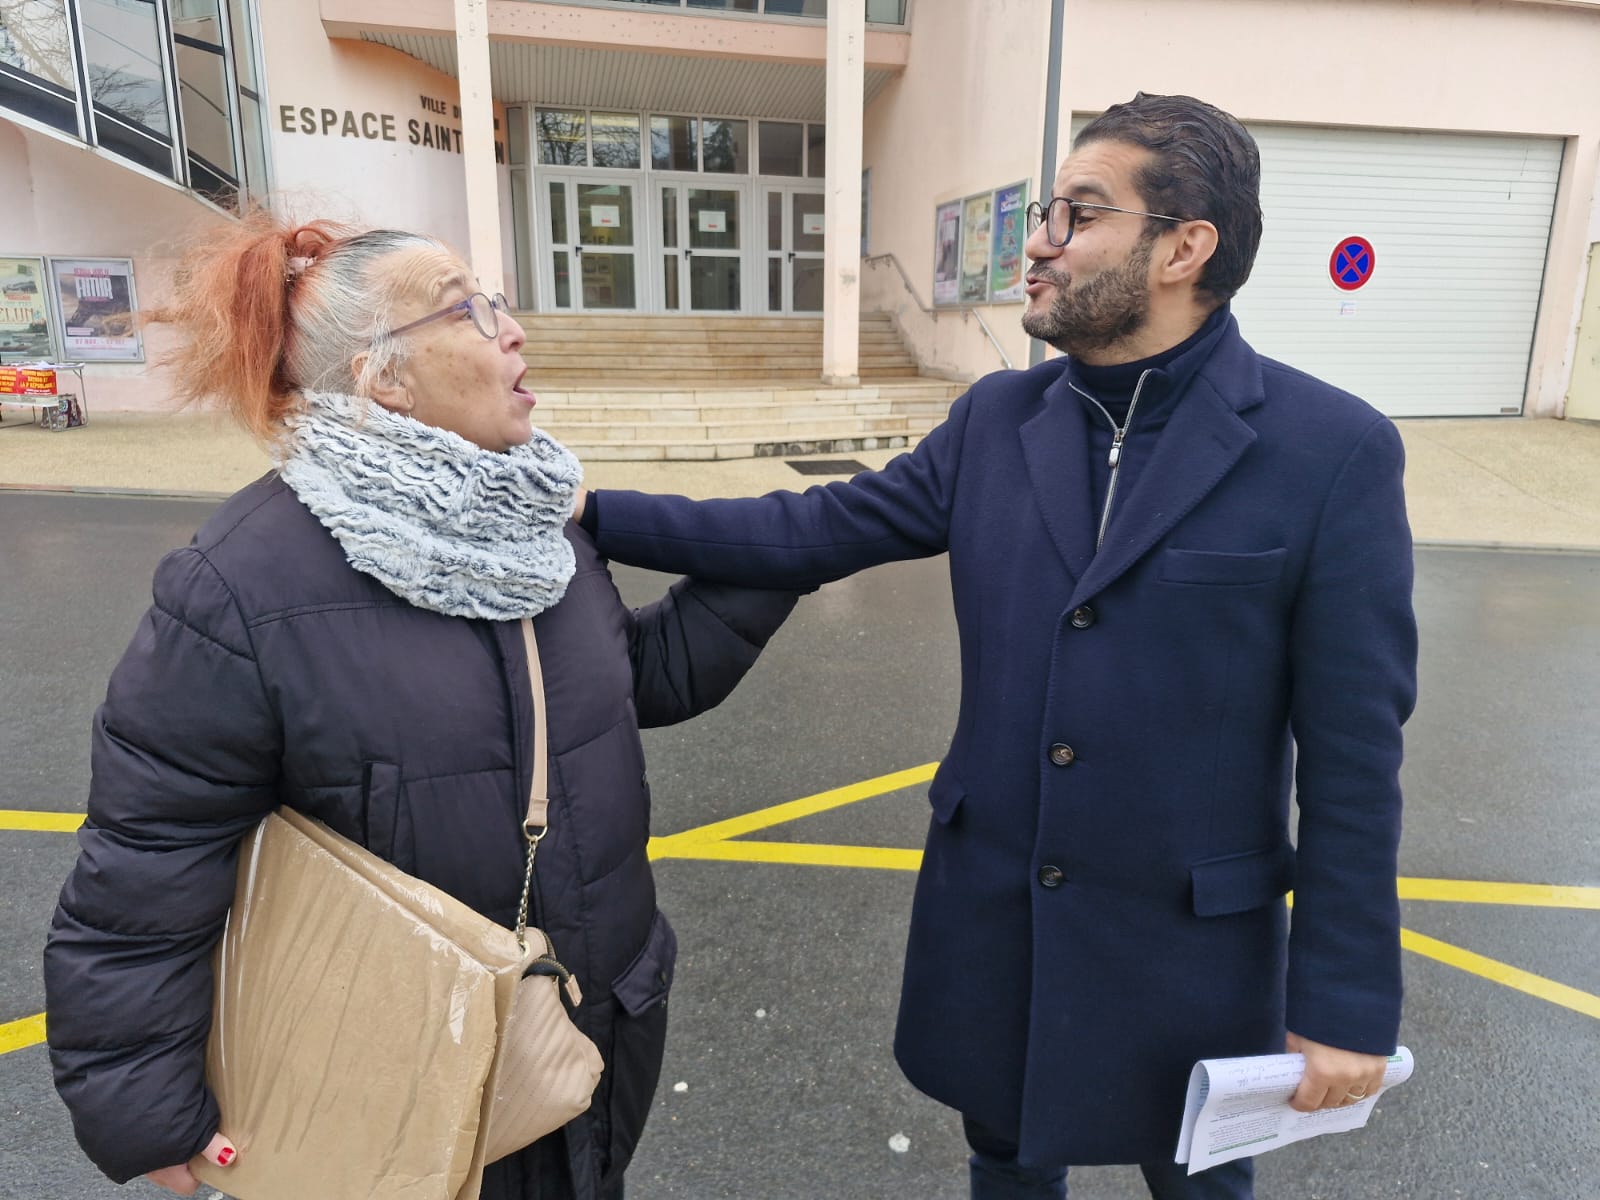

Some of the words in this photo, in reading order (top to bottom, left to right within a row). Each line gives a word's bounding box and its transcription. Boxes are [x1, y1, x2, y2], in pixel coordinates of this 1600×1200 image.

[419, 94, 447, 116] VILLE
[279, 104, 397, 142] ESPACE
[408, 118, 462, 154] SAINT
